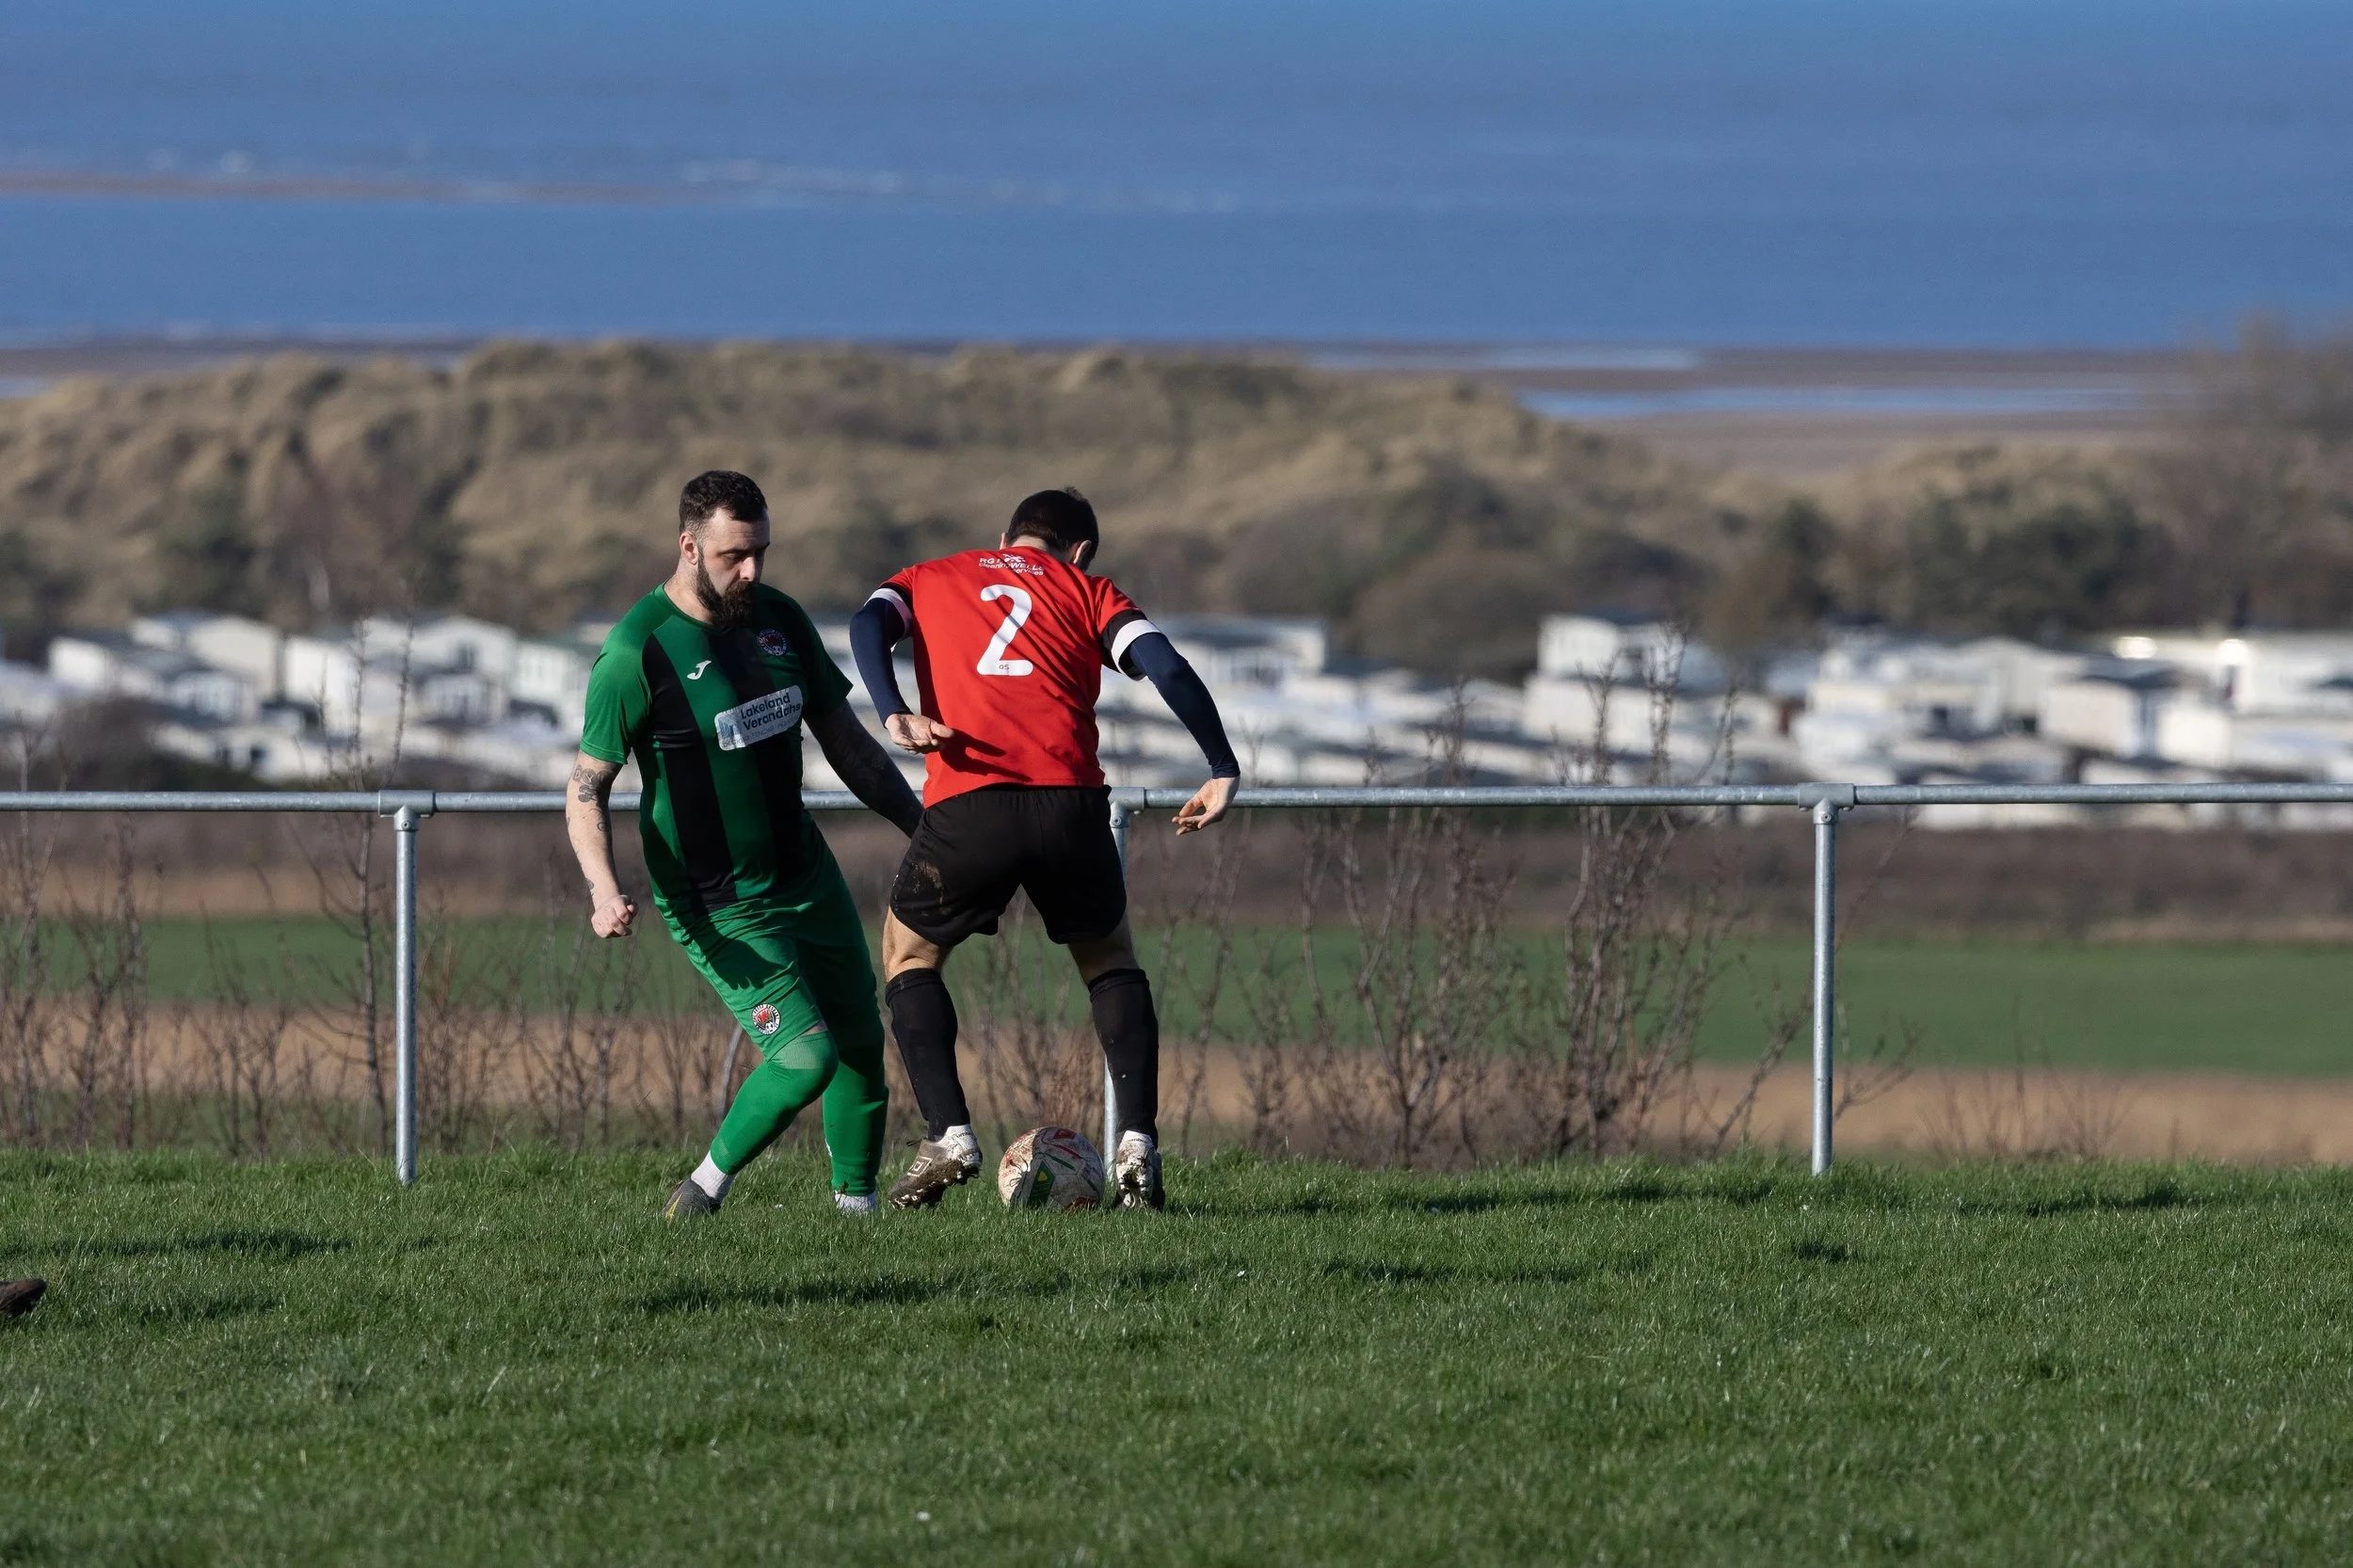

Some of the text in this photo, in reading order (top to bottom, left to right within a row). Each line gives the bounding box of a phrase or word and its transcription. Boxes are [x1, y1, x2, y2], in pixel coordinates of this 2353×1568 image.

[977, 584, 1033, 676] 2
[740, 693, 791, 719] Lakeland
[743, 703, 801, 730] Verandahs
